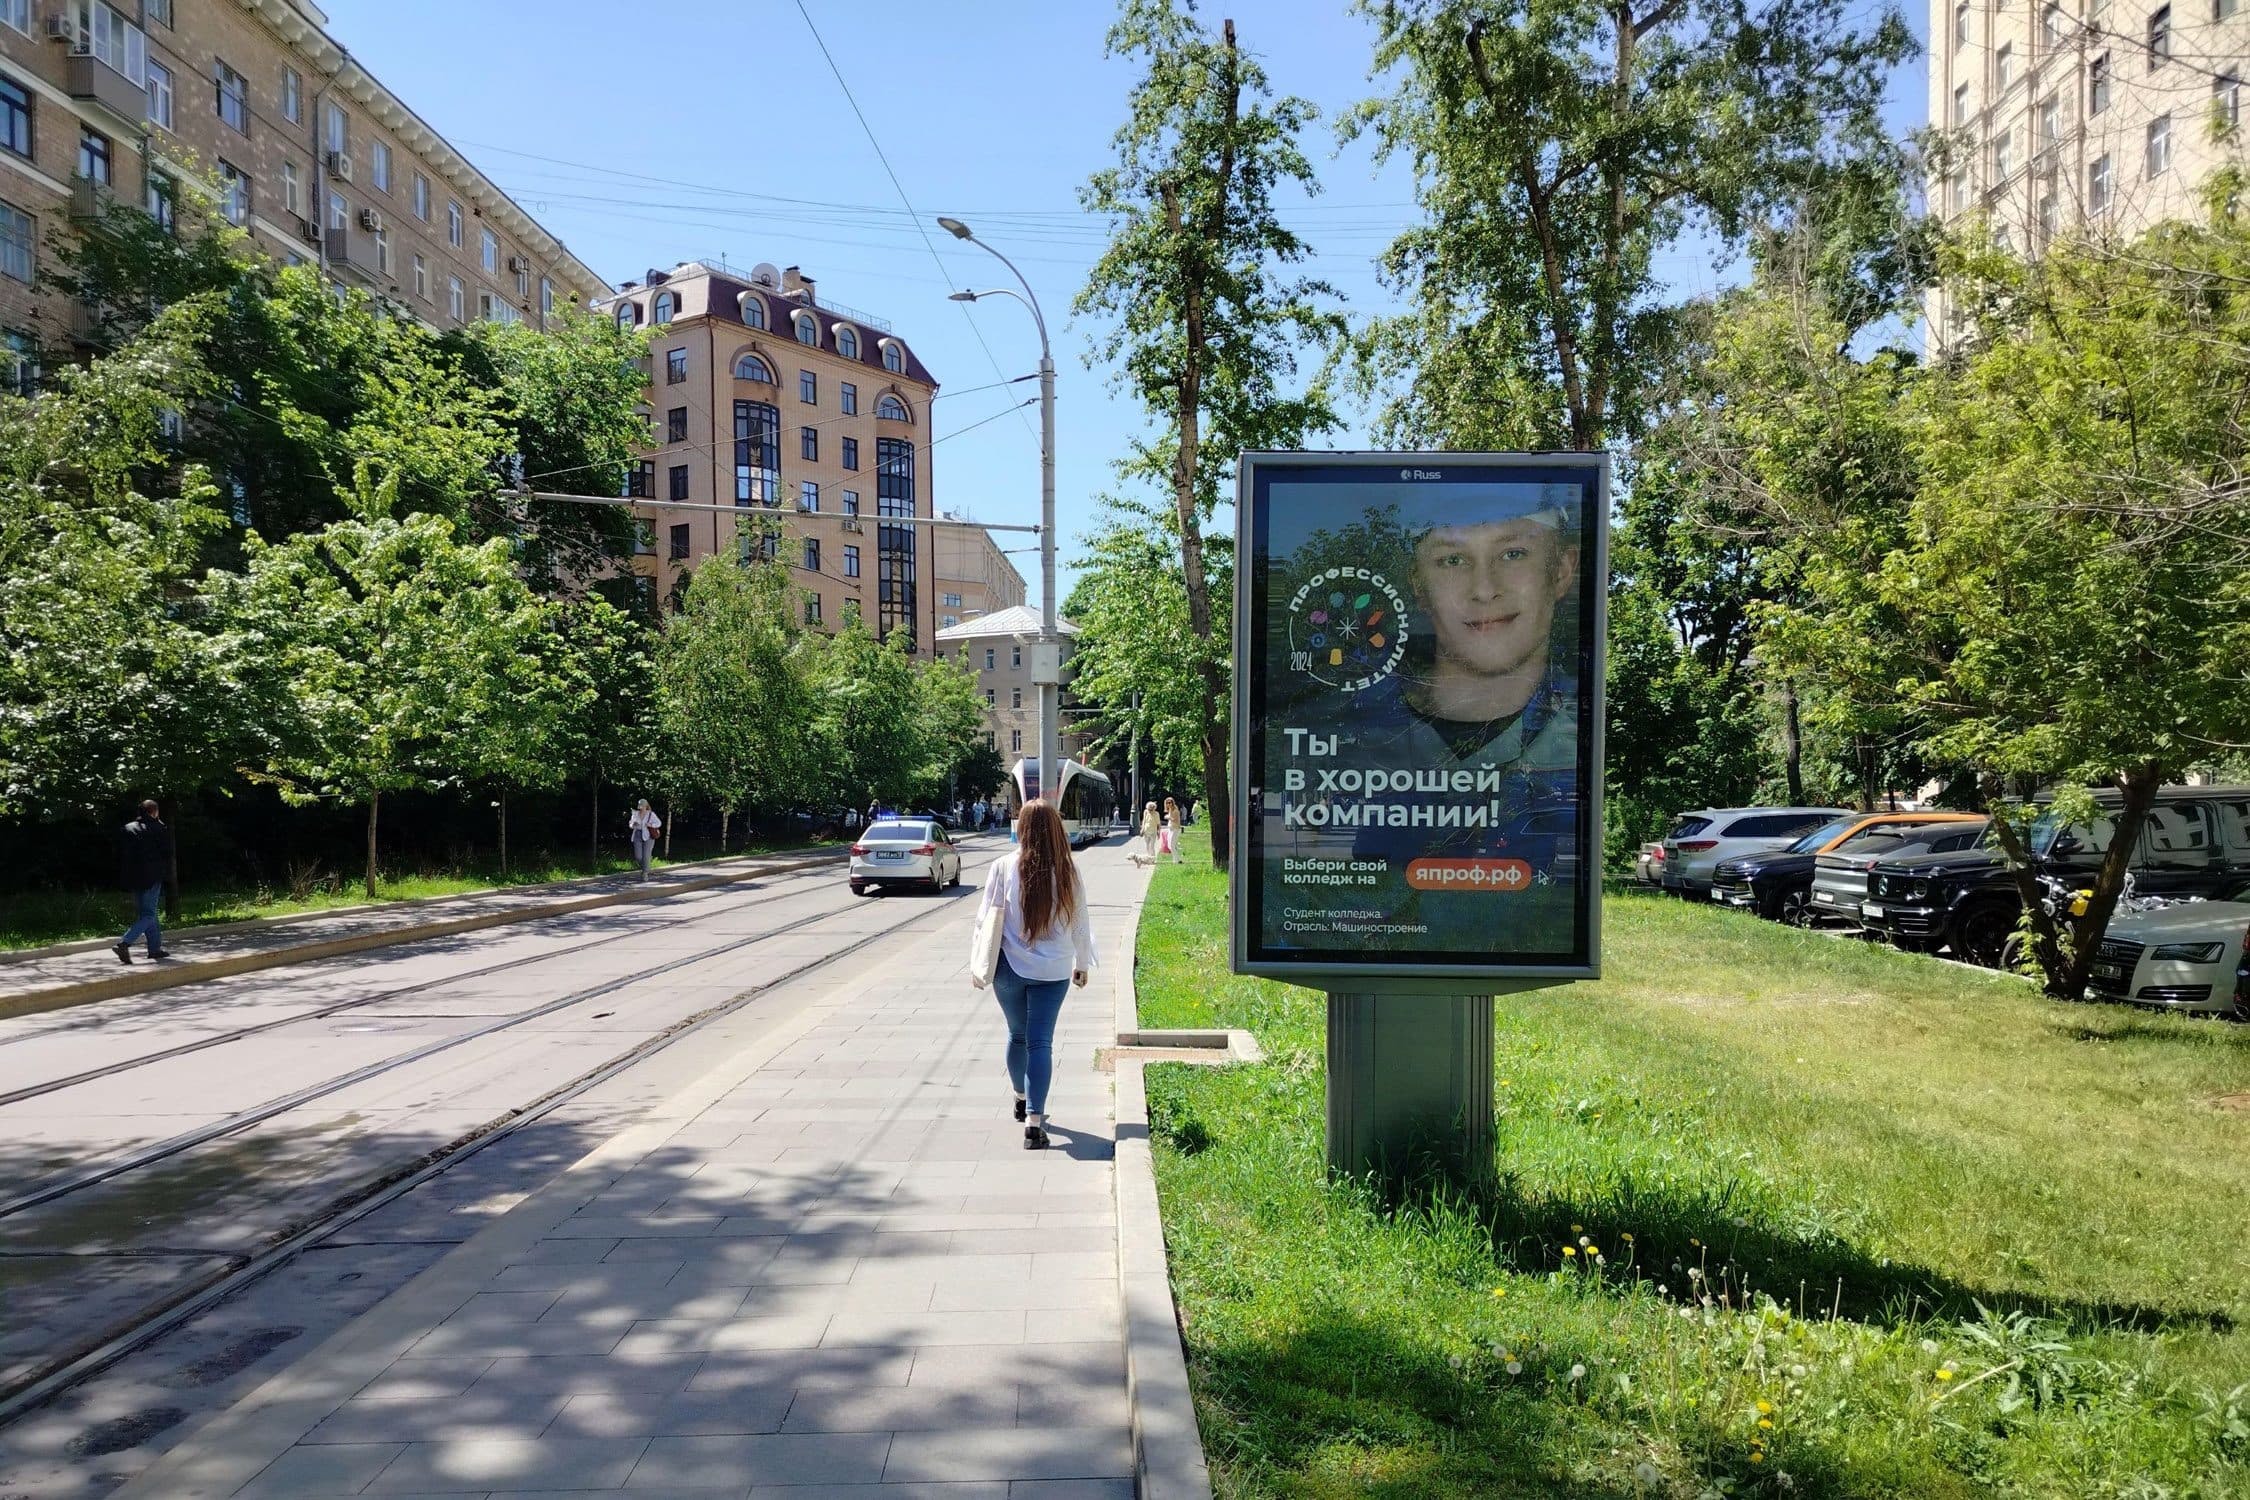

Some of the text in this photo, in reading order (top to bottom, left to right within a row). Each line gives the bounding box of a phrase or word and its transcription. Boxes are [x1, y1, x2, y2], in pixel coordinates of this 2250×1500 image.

[1414, 470, 1441, 480] Russ
[1289, 567, 1408, 691] ПРОФЕССИОНАЛИТЕТ
[1290, 651, 1312, 671] 2024
[1284, 728, 1337, 756] Ты
[1285, 763, 1500, 798] в хорошей
[1284, 800, 1499, 828] компании!
[1284, 859, 1387, 873] Выбери свой
[1416, 864, 1521, 885] япроф.рф
[1284, 874, 1376, 885] колледж на
[1283, 907, 1383, 919] Студент колледжа.
[1283, 920, 1428, 934] Отрасль: Машиностроение
